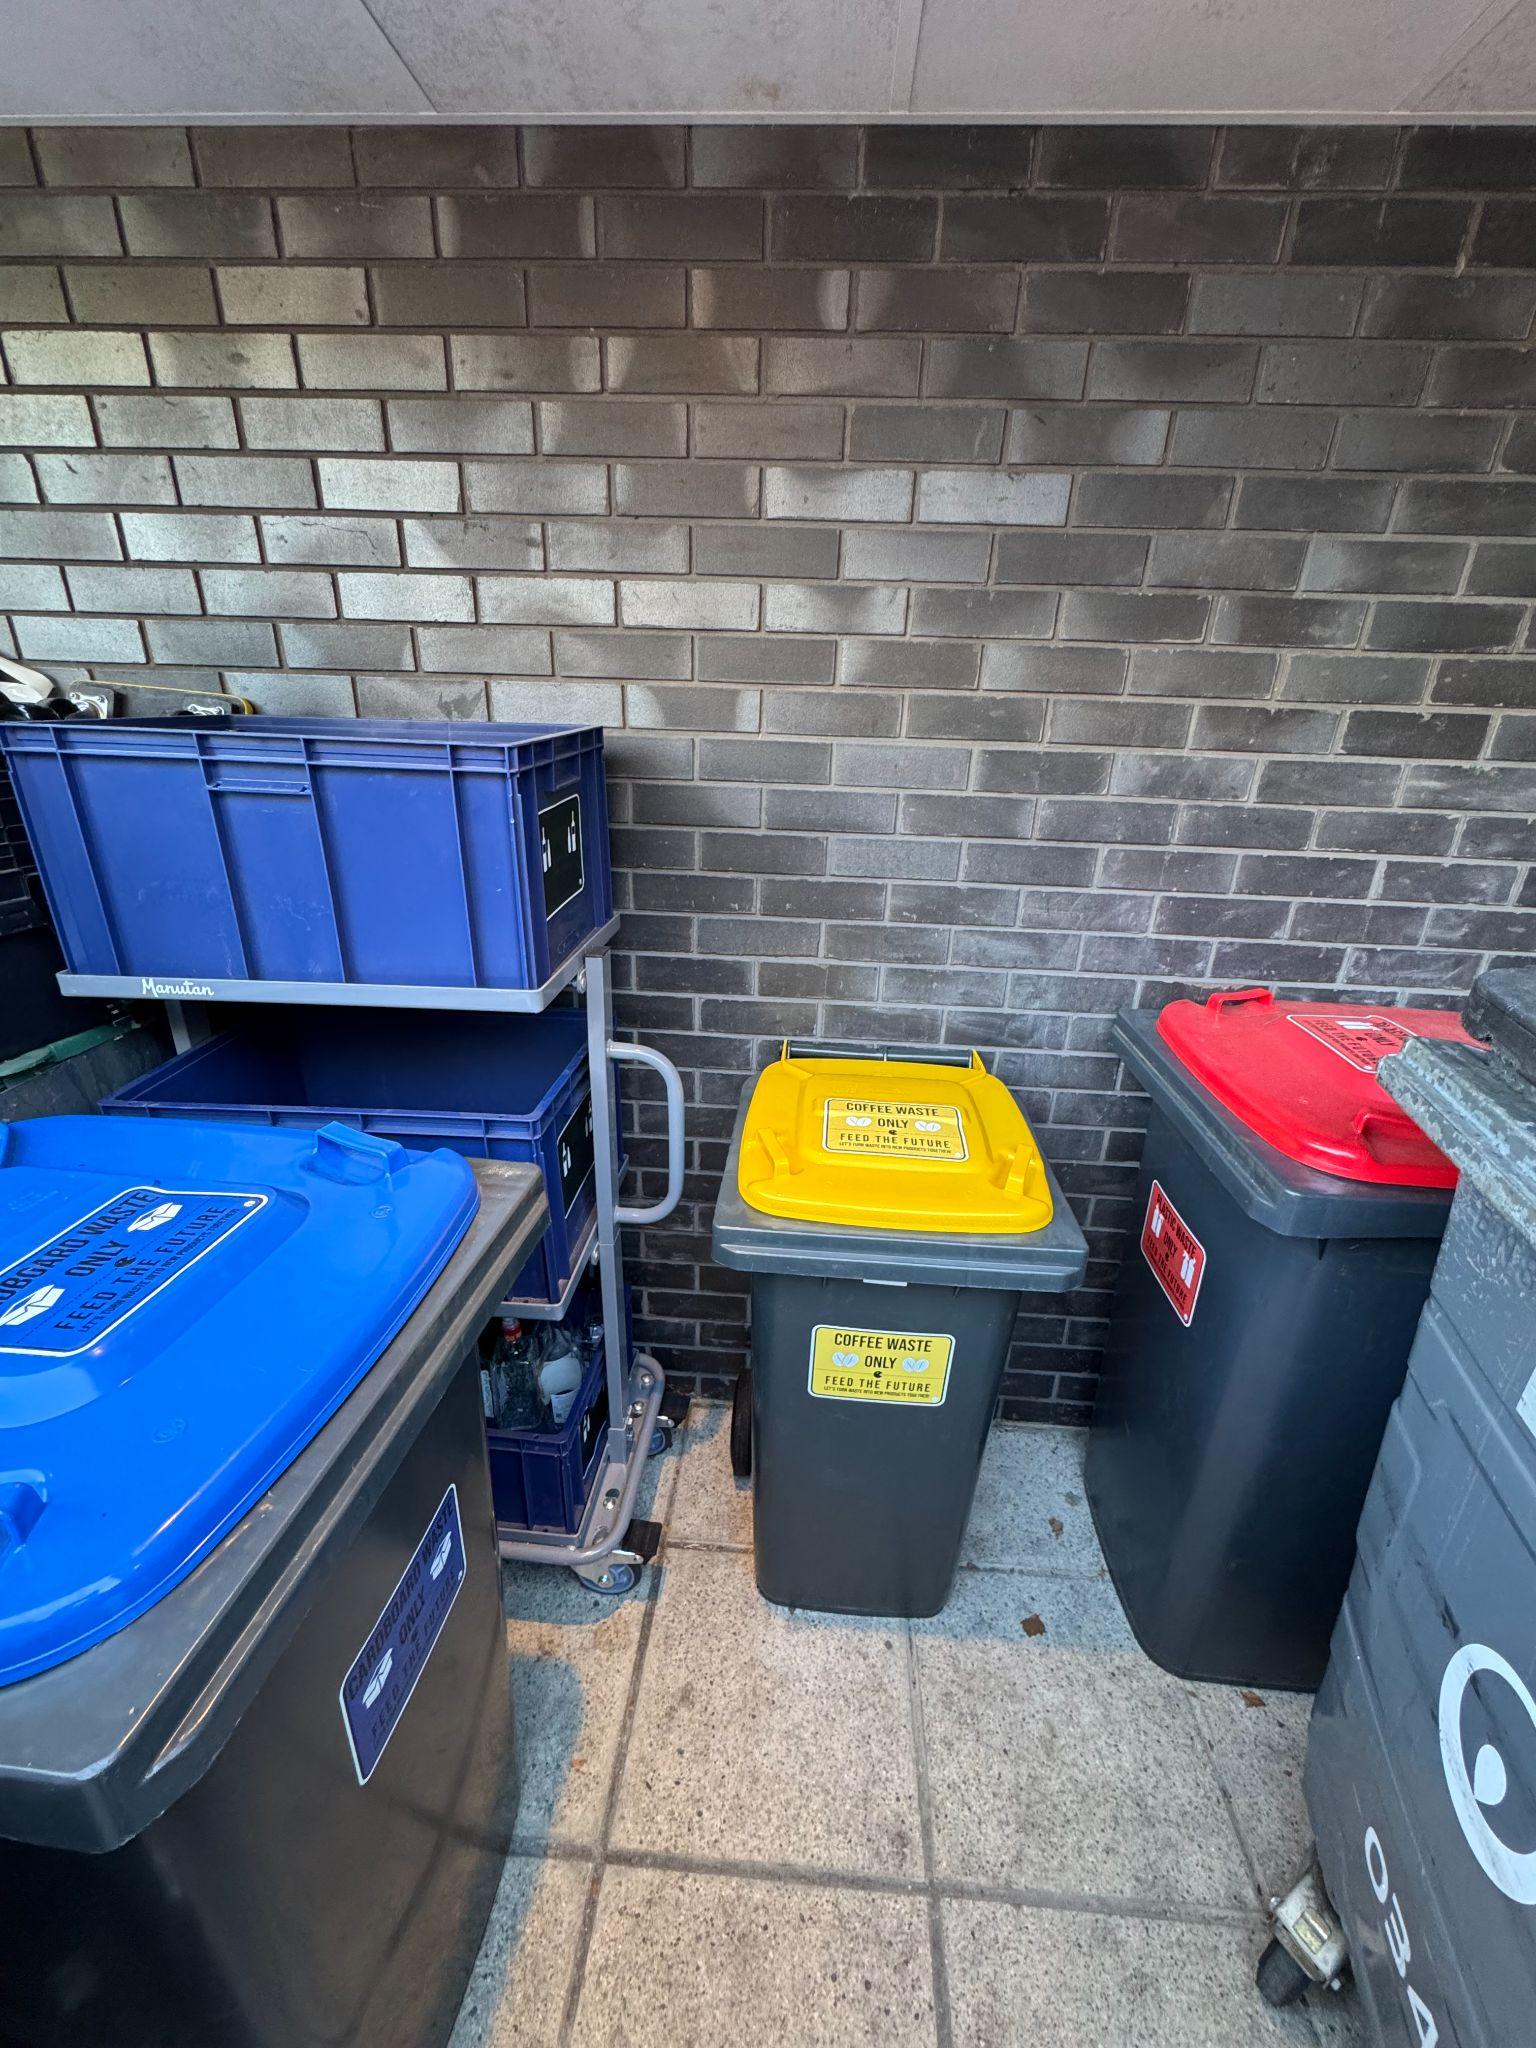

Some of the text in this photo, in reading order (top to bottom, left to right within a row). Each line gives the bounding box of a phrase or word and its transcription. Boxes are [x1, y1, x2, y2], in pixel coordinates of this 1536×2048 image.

[141, 978, 214, 998] Manutan
[846, 1102, 940, 1117] COFFEE WASTE
[877, 1118, 909, 1129] ONLY
[840, 1133, 951, 1149] FEED THE FUTURE
[77, 1192, 161, 1236] WASTE
[1156, 1193, 1177, 1232] PLASTIC
[1176, 1223, 1197, 1259] WASTE
[1163, 1231, 1178, 1258] ONLY
[54, 1206, 230, 1331] FEED THE FUTURE
[64, 1240, 130, 1277] ONLY
[834, 1333, 933, 1353] COFFEE WASTE
[864, 1355, 898, 1369] ONLY
[825, 1375, 932, 1393] FEED THE FUTURE
[347, 1561, 421, 1701] CARDBOARD
[421, 1498, 454, 1565] WASTE
[398, 1584, 426, 1646] ONLY
